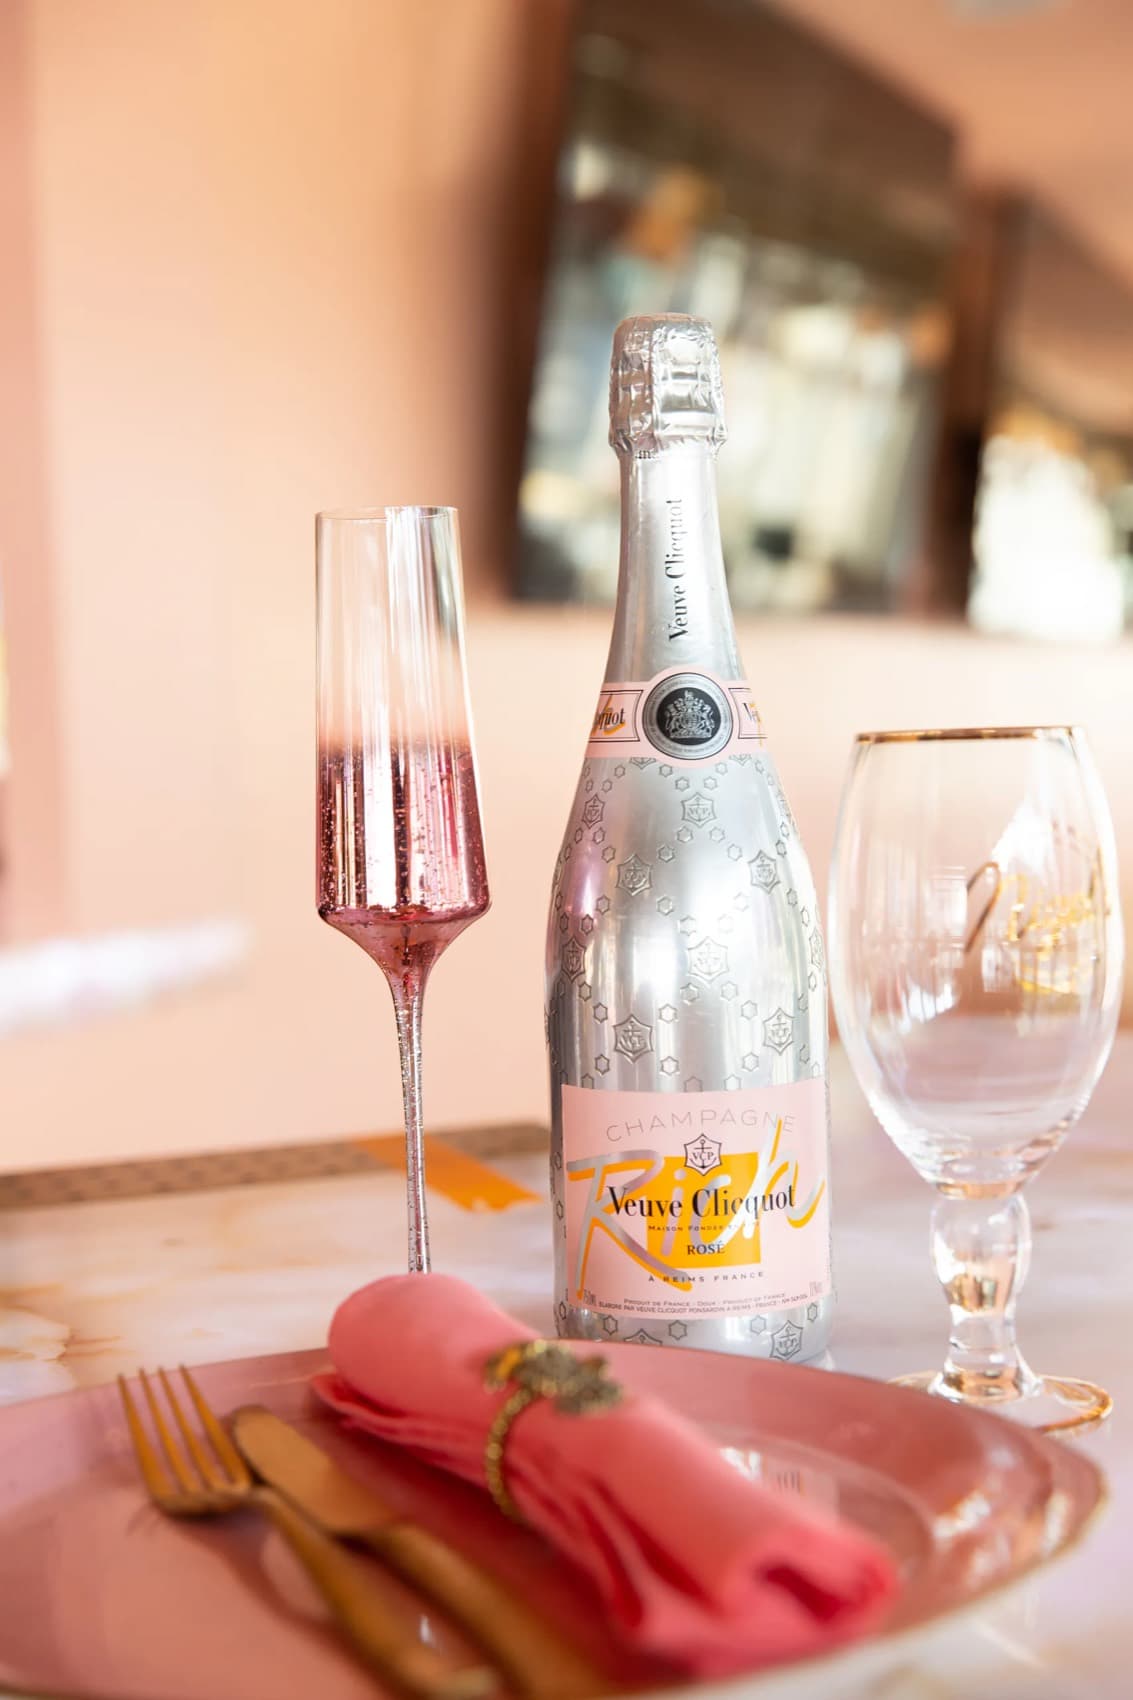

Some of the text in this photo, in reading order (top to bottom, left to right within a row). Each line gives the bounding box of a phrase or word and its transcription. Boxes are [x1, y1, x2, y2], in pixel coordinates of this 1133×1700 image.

[665, 499, 690, 642] Veuve Clicquot
[606, 1108, 796, 1142] CHAMPAGNE
[566, 1112, 826, 1300] Rich
[608, 1184, 796, 1219] Veuve Clicquot
[687, 1240, 725, 1255] ROSÉ
[663, 1275, 705, 1283] REIMS
[713, 1271, 764, 1281] FRANCE
